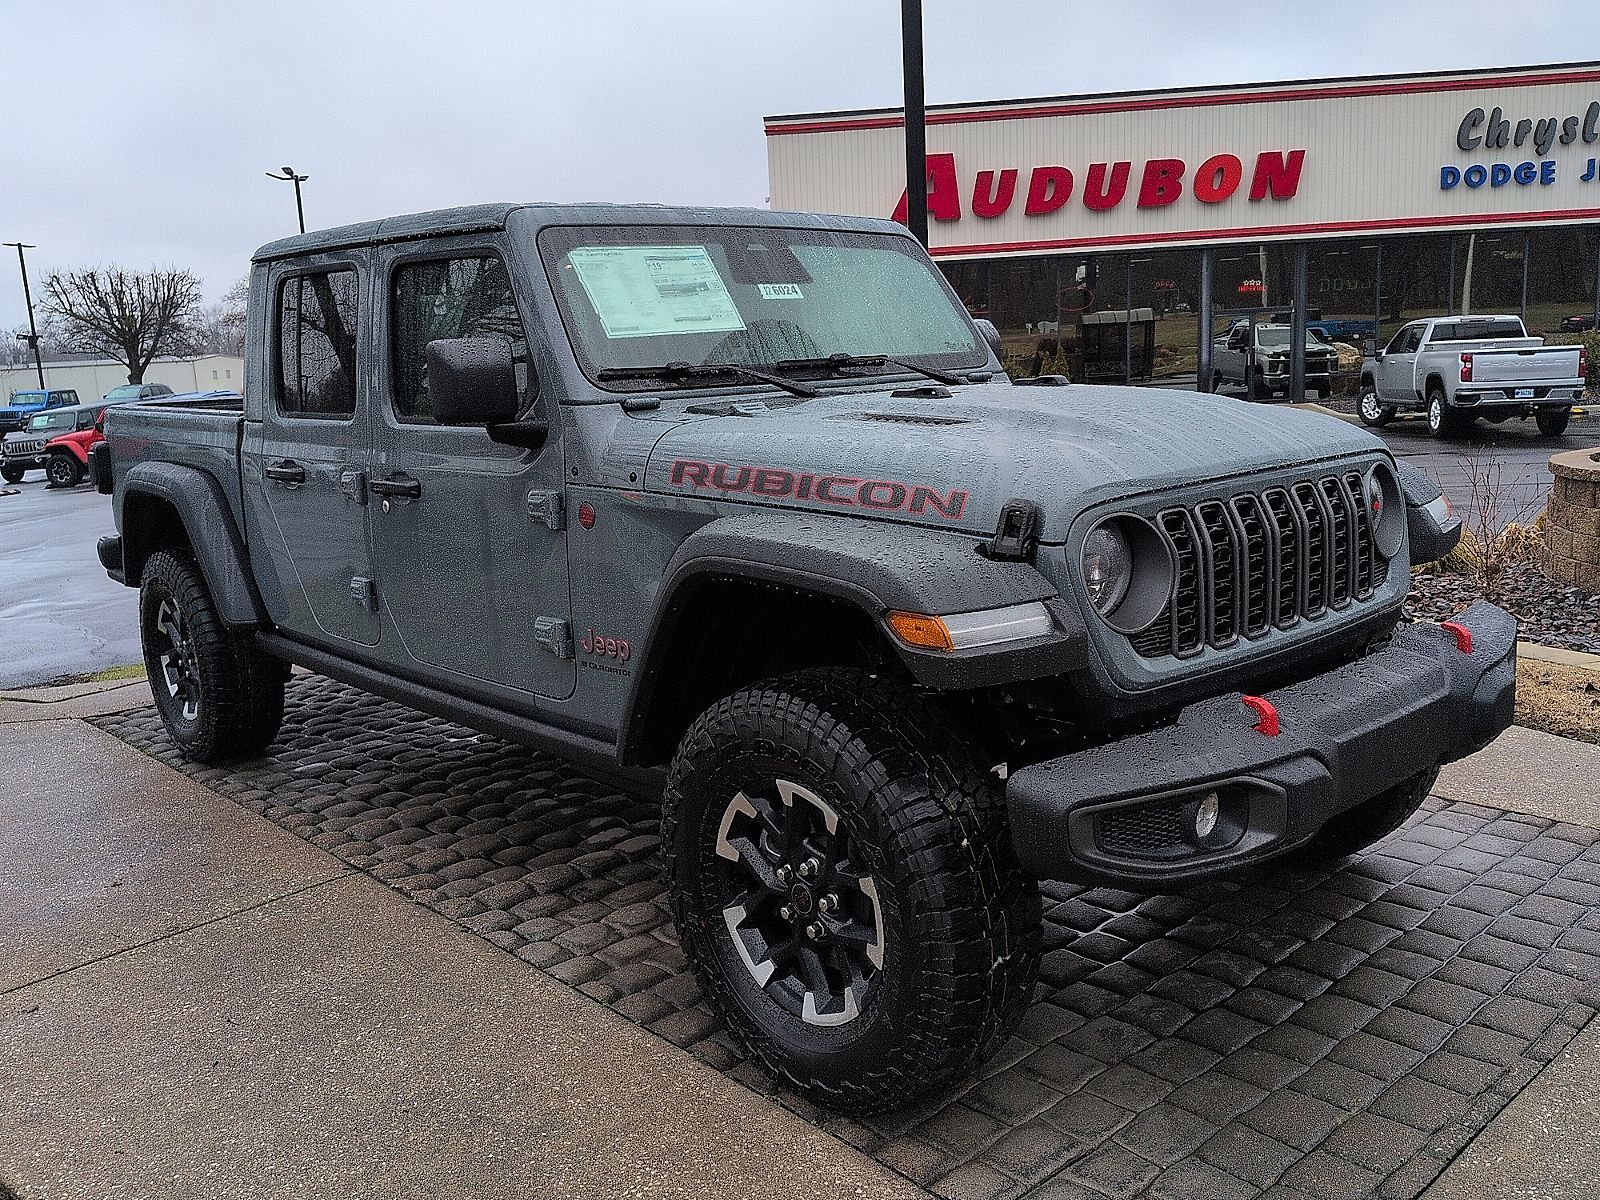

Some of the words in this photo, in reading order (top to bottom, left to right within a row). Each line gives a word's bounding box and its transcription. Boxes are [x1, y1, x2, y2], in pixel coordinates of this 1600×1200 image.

[891, 150, 1306, 222] AUDUBON
[1440, 160, 1556, 190] DODGE
[670, 458, 968, 520] RUBICON
[580, 627, 631, 665] Jeep
